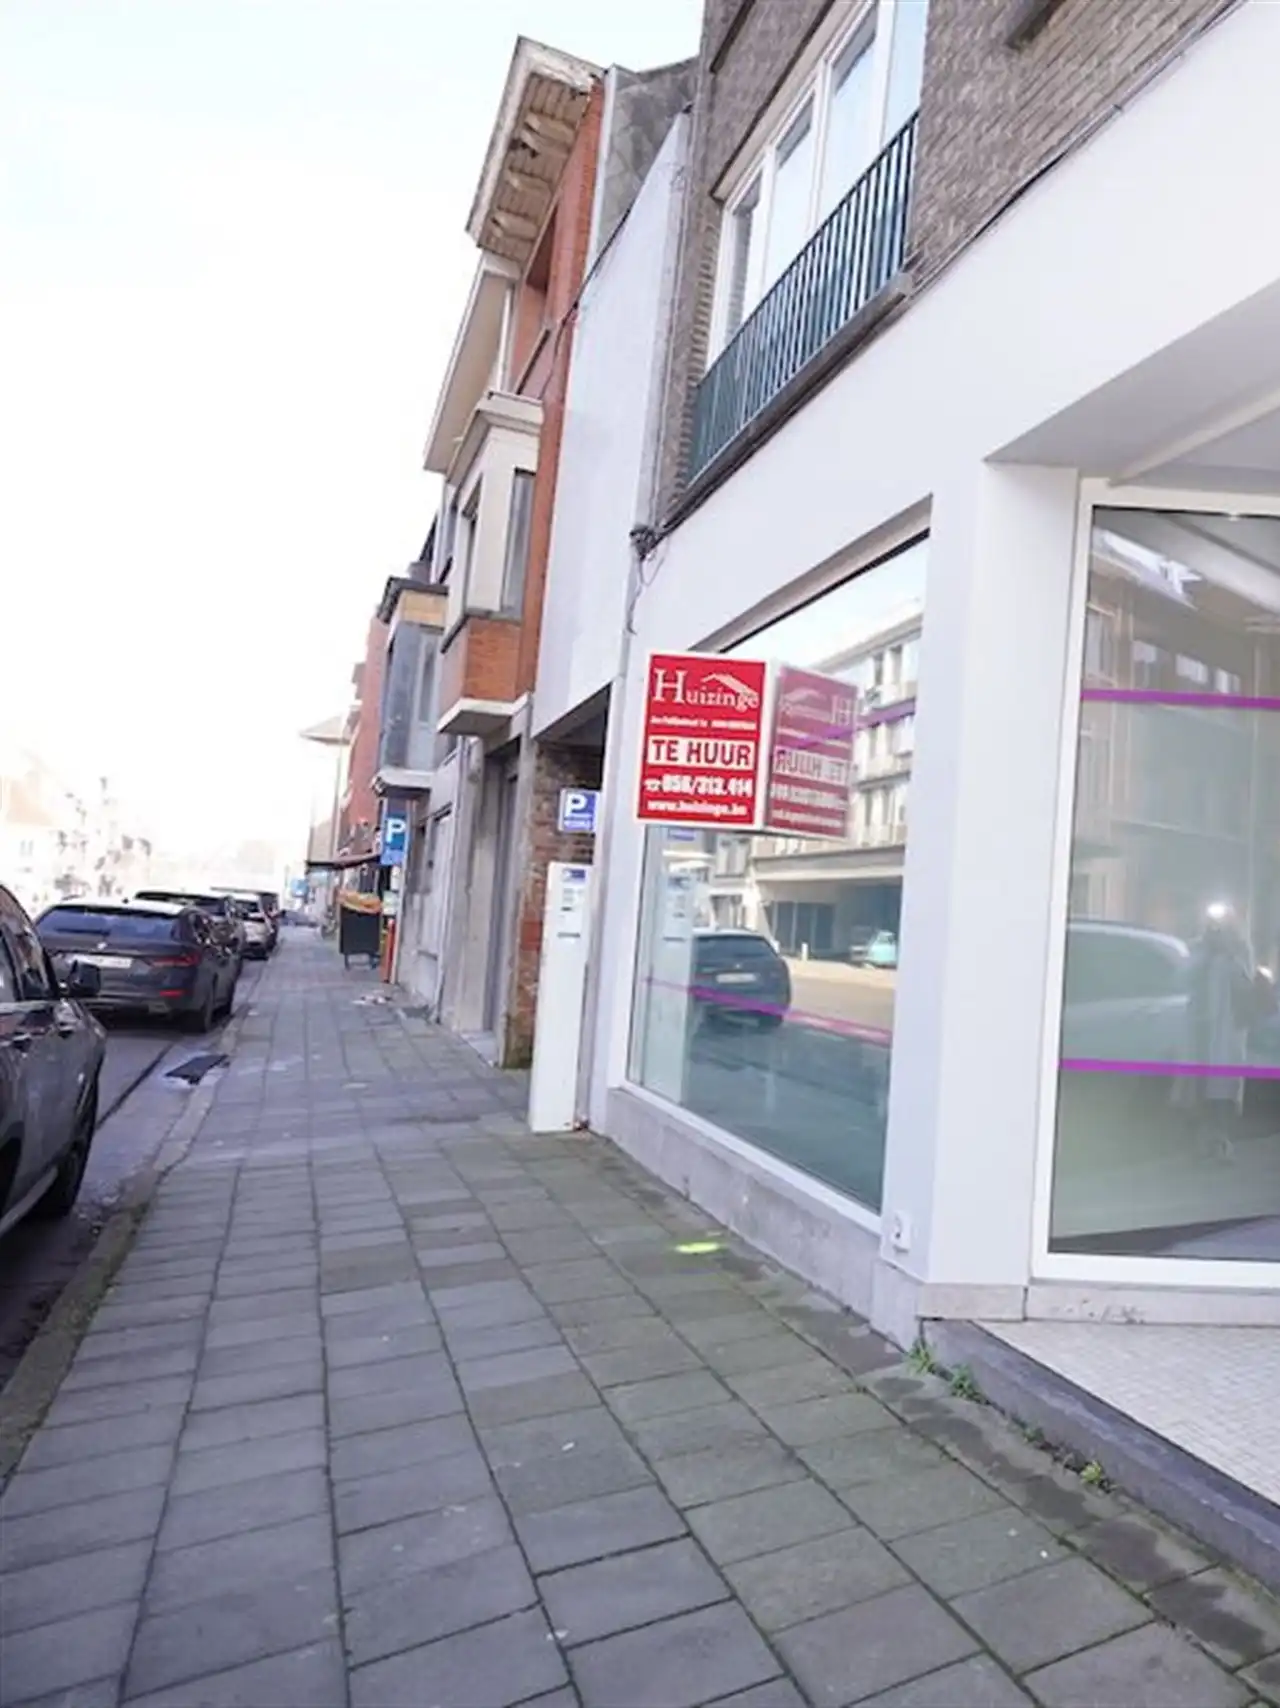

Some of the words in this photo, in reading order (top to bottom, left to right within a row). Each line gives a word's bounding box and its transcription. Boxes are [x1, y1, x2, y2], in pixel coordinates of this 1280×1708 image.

[652, 739, 679, 761] TE
[686, 741, 752, 766] HUUR
[565, 793, 588, 817] P
[386, 818, 406, 844] P
